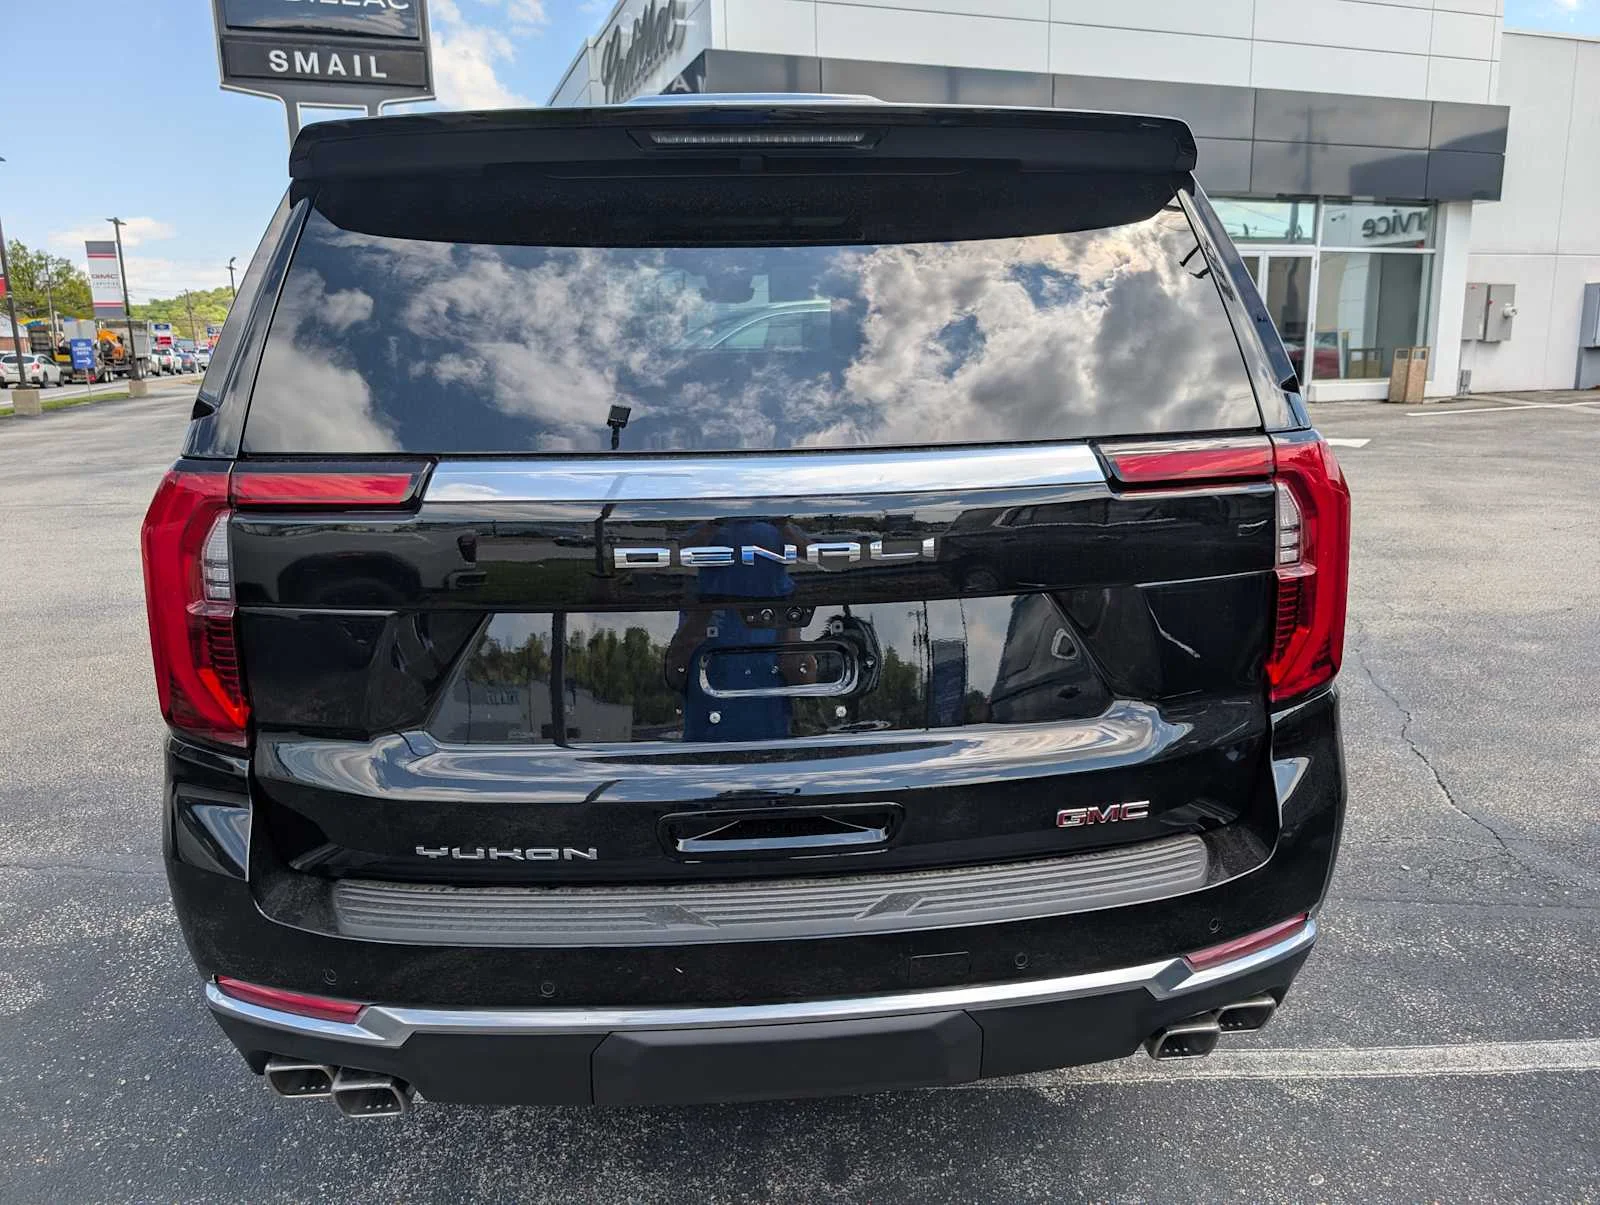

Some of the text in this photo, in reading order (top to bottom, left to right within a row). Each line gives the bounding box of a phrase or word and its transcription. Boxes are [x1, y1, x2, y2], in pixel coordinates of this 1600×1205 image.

[269, 49, 387, 78] SMAIL
[614, 537, 936, 569] DENALI
[1056, 800, 1150, 827] GMC
[415, 846, 598, 860] YUKON
